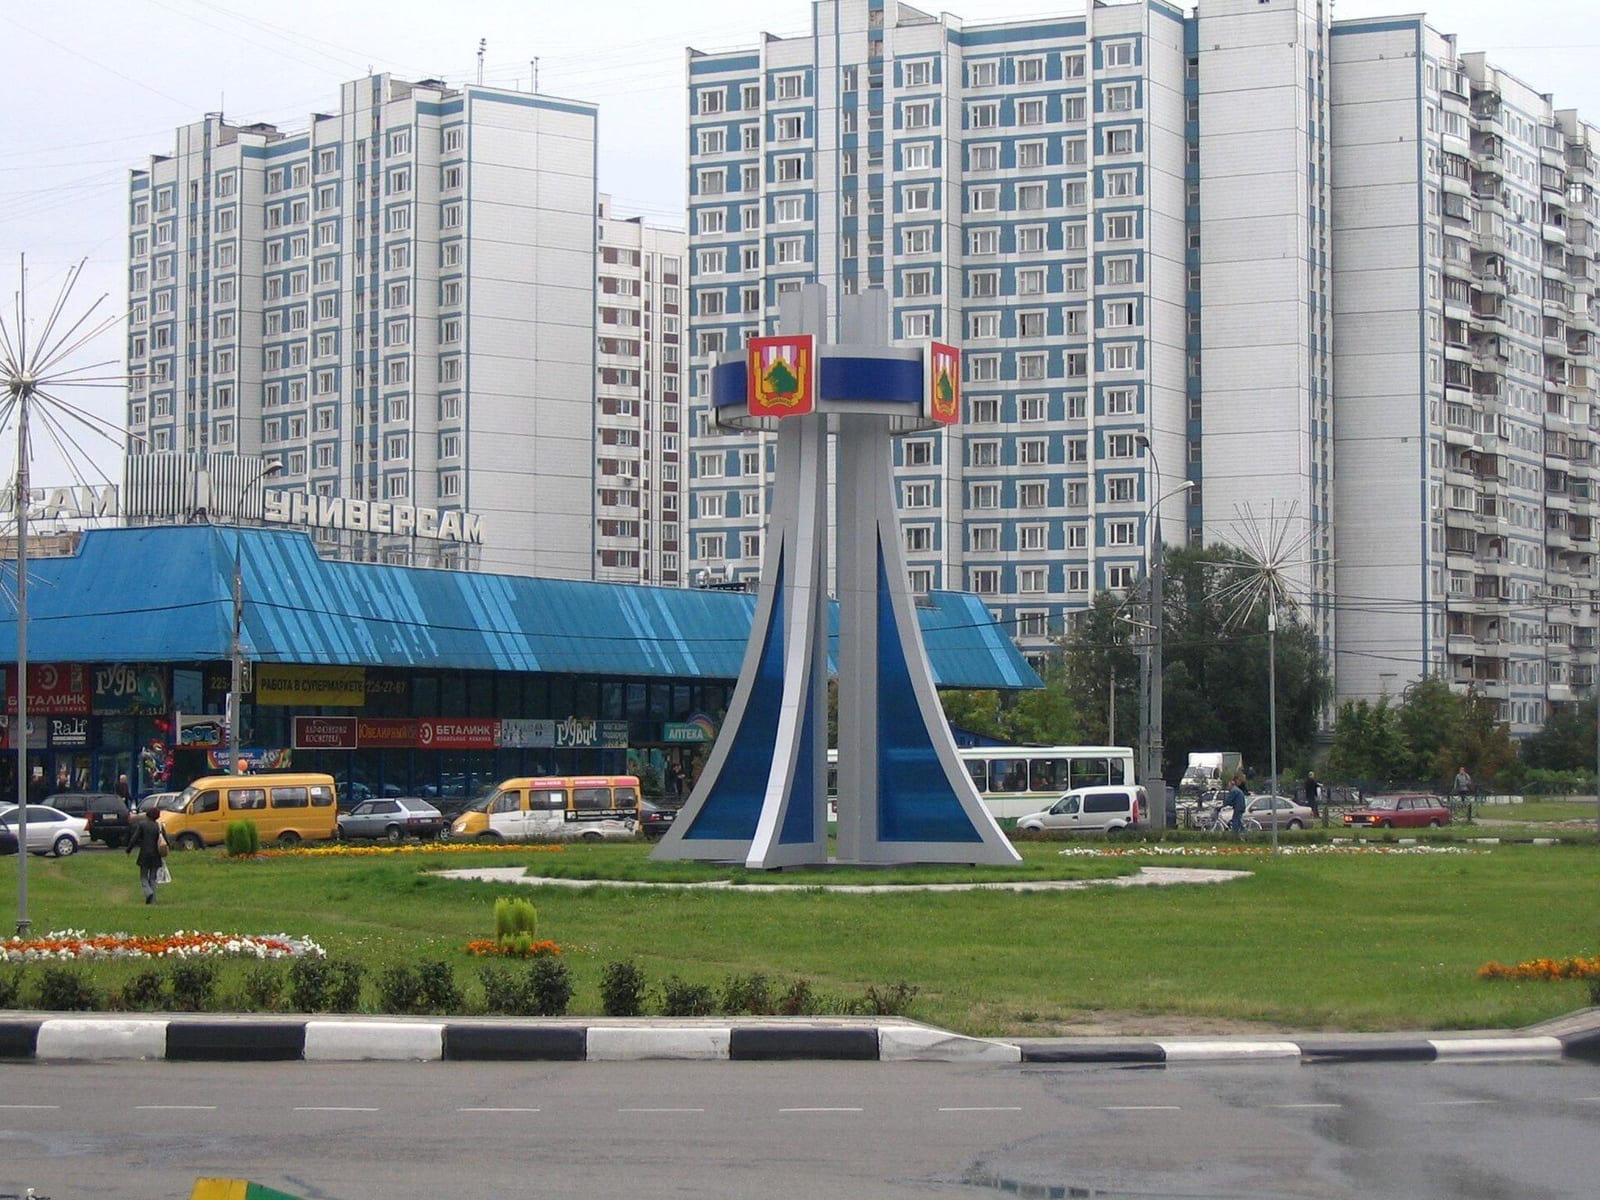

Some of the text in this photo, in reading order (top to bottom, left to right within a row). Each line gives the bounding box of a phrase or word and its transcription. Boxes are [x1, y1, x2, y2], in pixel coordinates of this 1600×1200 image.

[264, 489, 487, 544] УНИВЕРСАМ
[261, 679, 364, 692] РАБОТА В СУПЕРМАРКЕТЕ
[8, 694, 87, 706] БТАЛИНК
[52, 717, 88, 736] Ralf
[436, 725, 490, 735] БЕТАЛИНК
[669, 728, 704, 739] АПТЕКА
